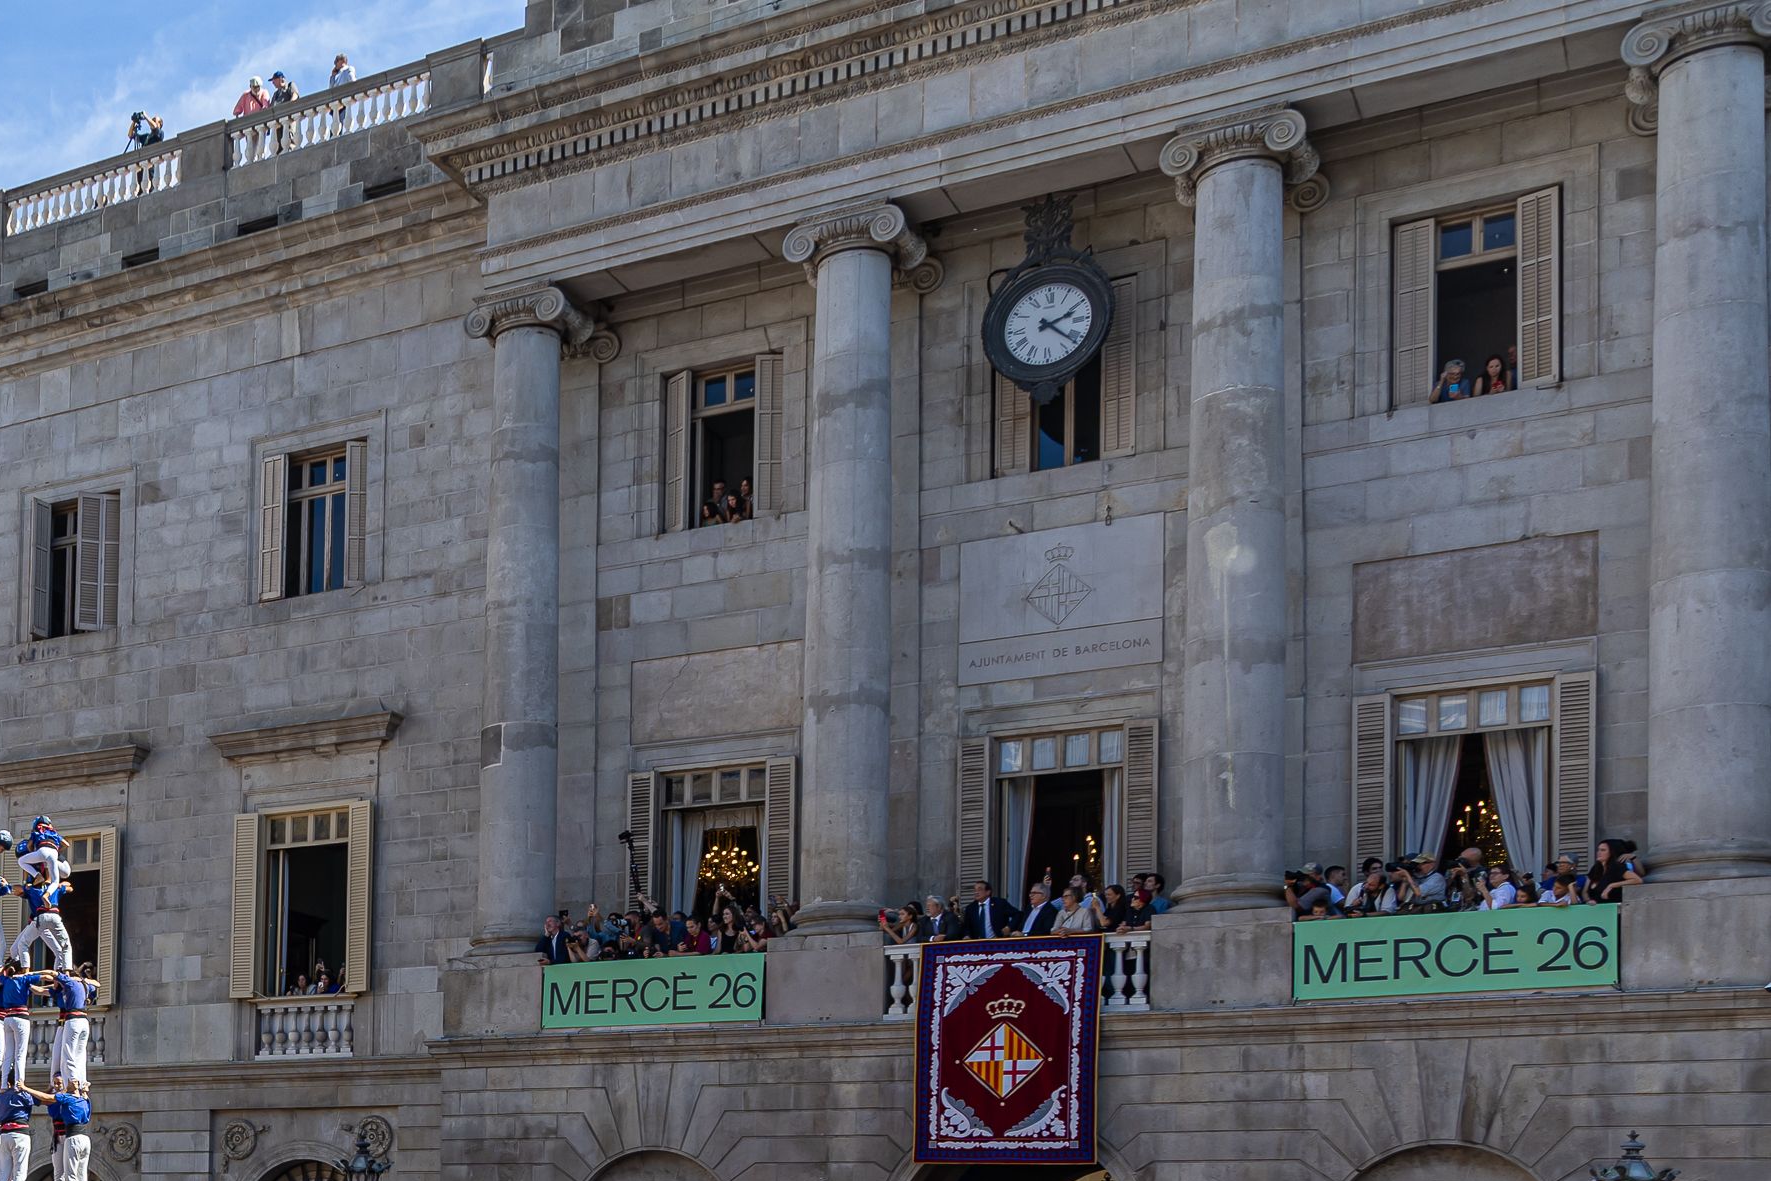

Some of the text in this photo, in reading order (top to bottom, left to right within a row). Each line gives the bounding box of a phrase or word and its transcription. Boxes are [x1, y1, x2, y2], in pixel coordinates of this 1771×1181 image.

[969, 637, 1151, 669] AJUNTAMENT DE BARCELONA
[1303, 926, 1609, 984] MERCÈ 26
[549, 971, 757, 1015] MERCÈ 26
